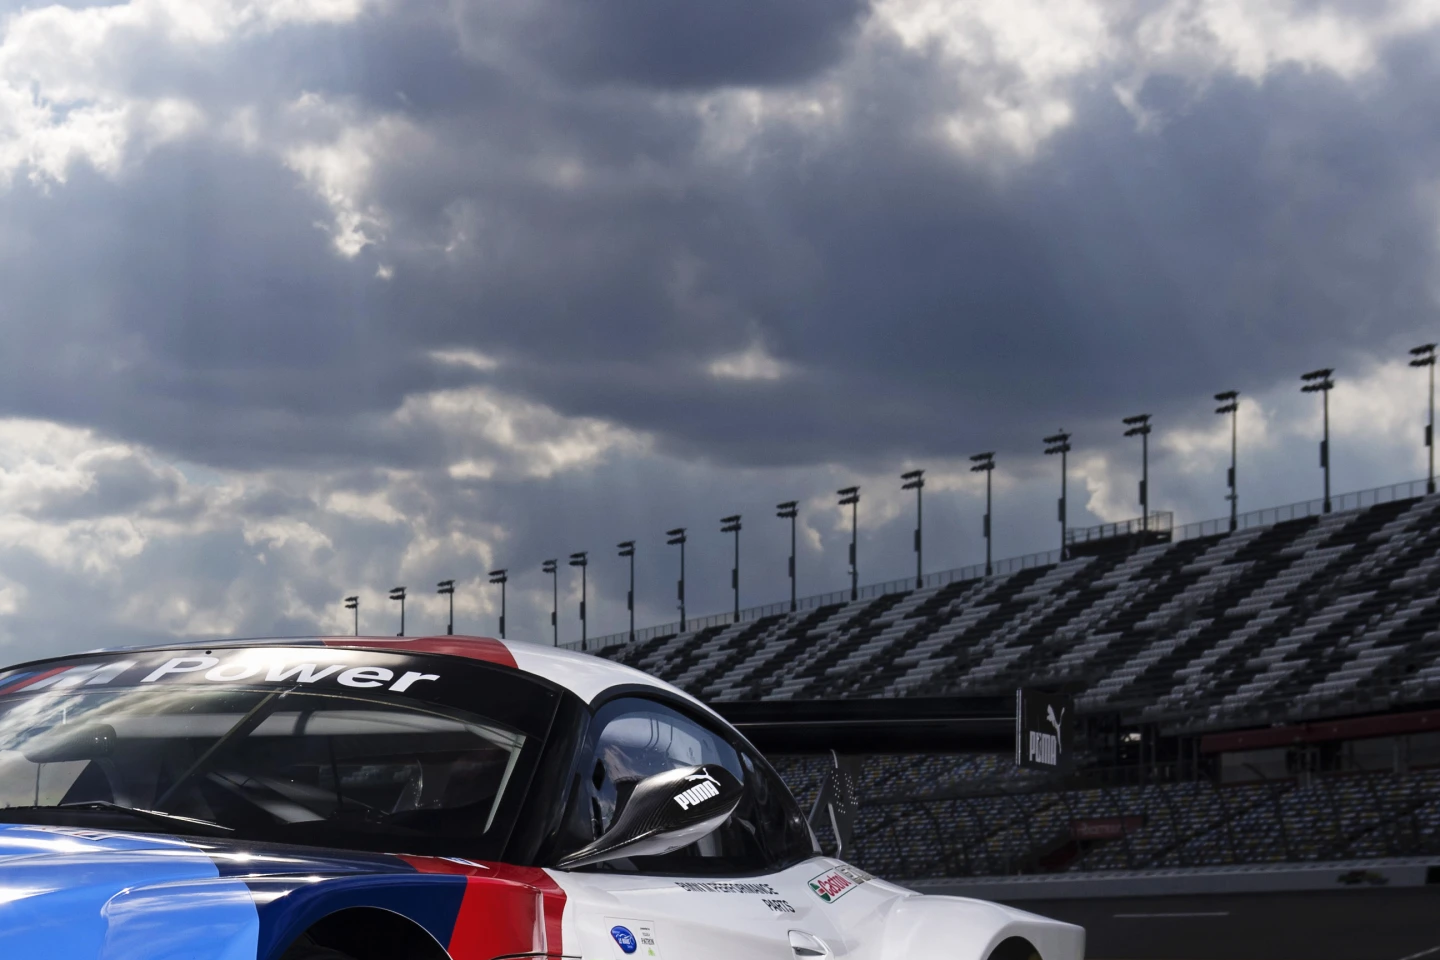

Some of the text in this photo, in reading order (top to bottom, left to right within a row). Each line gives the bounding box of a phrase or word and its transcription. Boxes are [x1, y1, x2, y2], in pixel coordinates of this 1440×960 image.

[139, 656, 441, 693] Power
[1029, 730, 1057, 766] PUMA
[673, 779, 720, 811] PUMA
[816, 871, 852, 897] Castrol
[762, 898, 796, 913] PARTS
